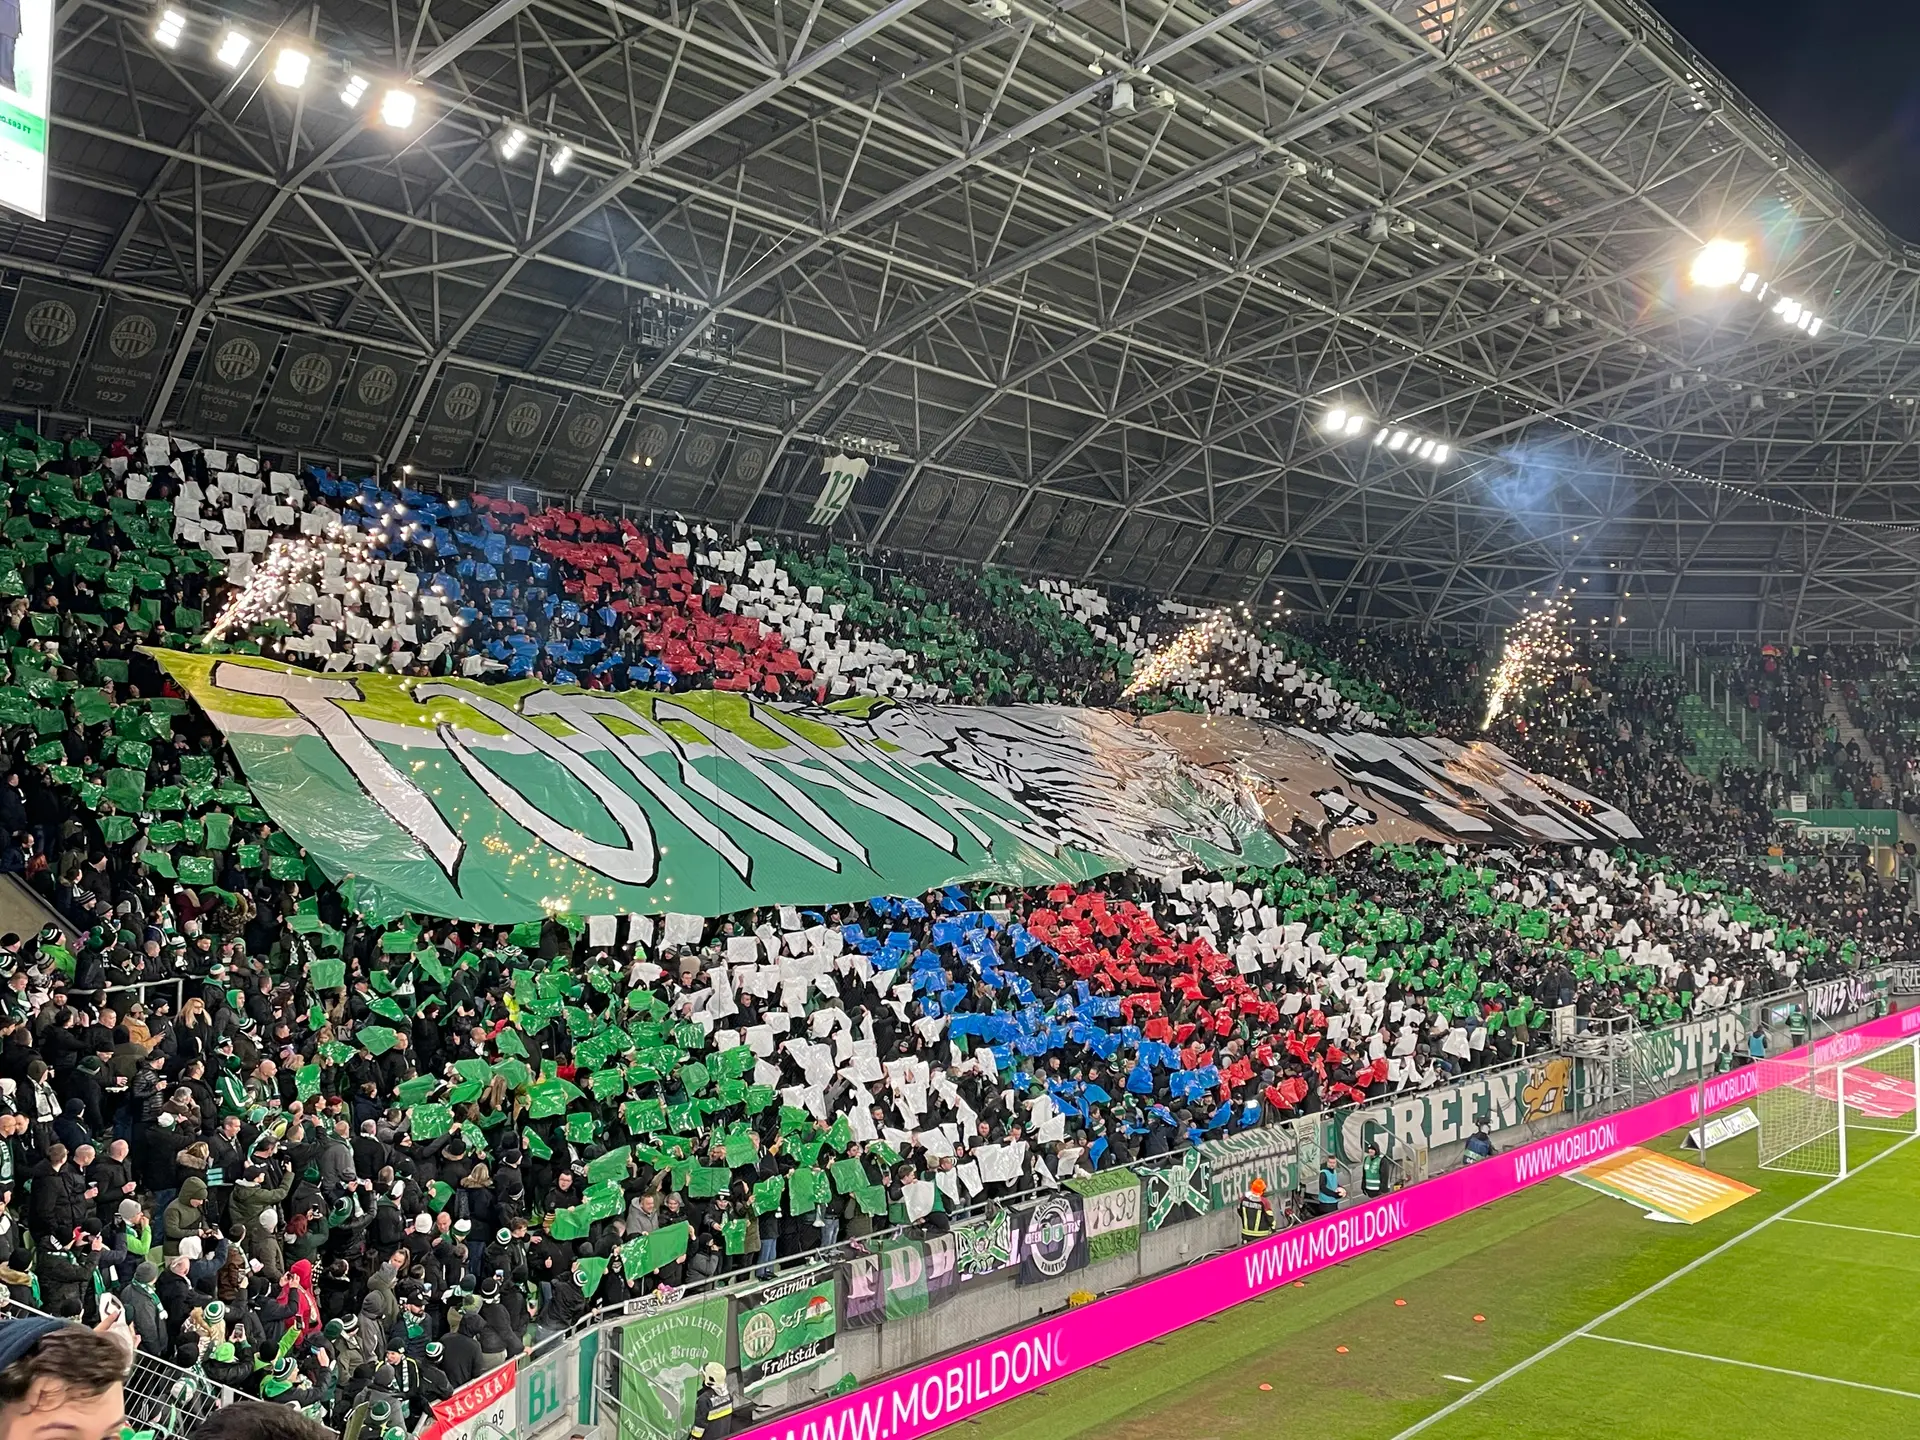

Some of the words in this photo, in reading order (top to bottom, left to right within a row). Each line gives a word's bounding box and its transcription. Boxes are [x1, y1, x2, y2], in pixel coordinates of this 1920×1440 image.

[3, 349, 44, 364] MAGYAR
[45, 356, 71, 369] KUPA
[91, 362, 126, 375] MAGYAR
[127, 368, 152, 380] KUPA
[11, 377, 44, 393] 1922
[95, 390, 128, 403] 1927
[275, 421, 300, 435] 1933
[824, 470, 854, 509] 12
[1858, 825, 1891, 836] Aréna
[1341, 1074, 1520, 1163] GREEN
[1221, 1155, 1290, 1204] GREENS
[1093, 1188, 1136, 1230] 1899
[1041, 1256, 1067, 1272] FANATICS
[760, 1273, 817, 1306] Szatmári
[628, 1316, 689, 1361] MEGHALNI
[691, 1316, 724, 1340] LEHET
